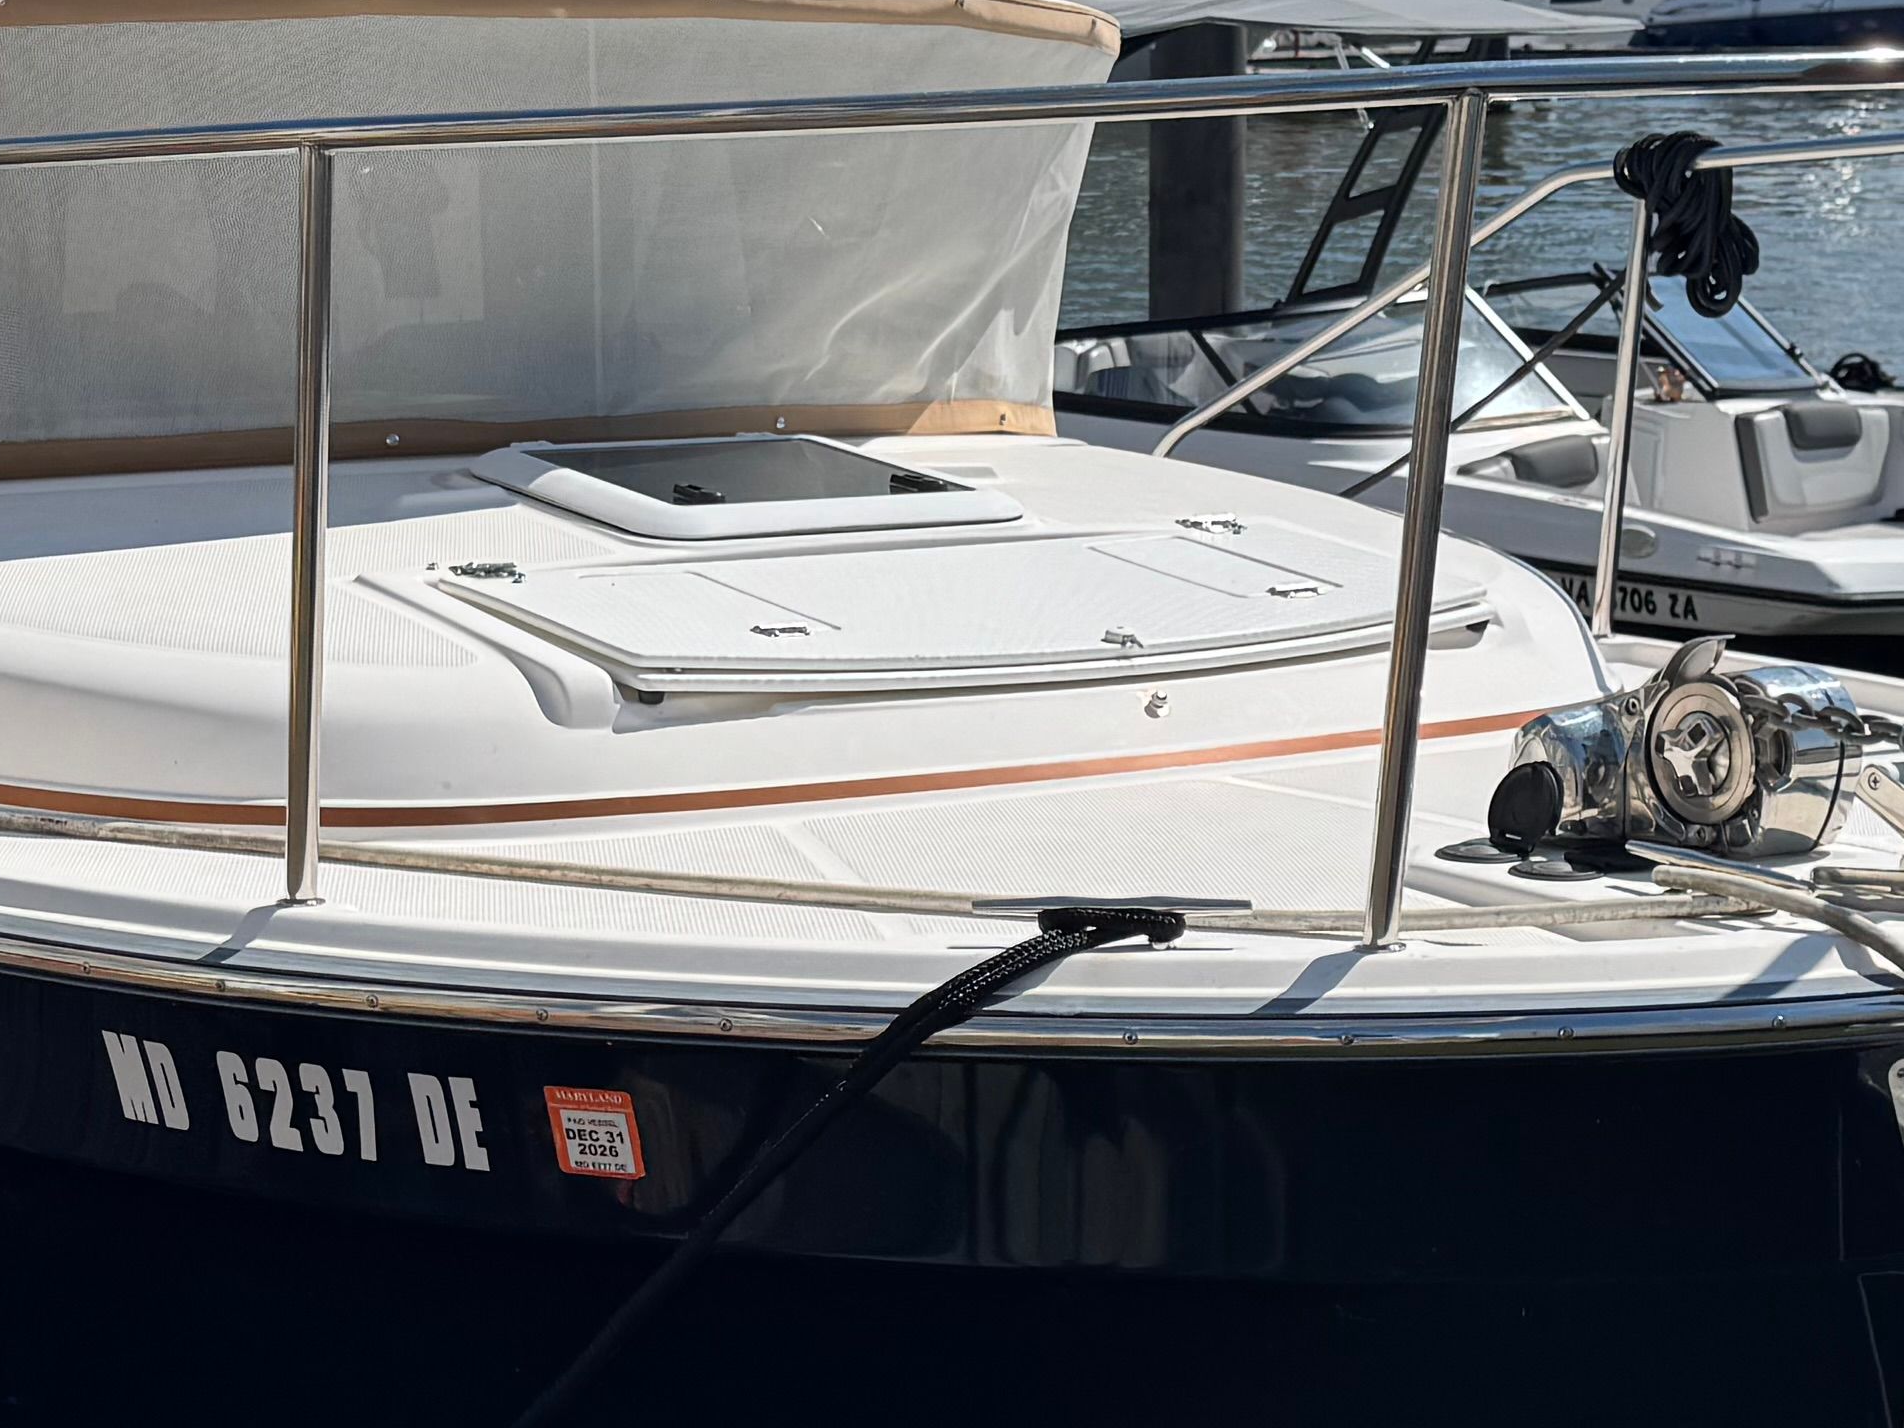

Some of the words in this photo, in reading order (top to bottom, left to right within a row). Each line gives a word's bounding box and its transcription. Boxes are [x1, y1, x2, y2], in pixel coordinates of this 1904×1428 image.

[1613, 586, 1658, 616] 706
[102, 1029, 190, 1131] MD
[216, 1051, 378, 1162] 6237
[407, 1073, 491, 1172] DE
[556, 1090, 623, 1104] MARYLAND
[565, 1128, 600, 1143] DEC
[605, 1130, 625, 1145] 31
[577, 1143, 619, 1158] 2026
